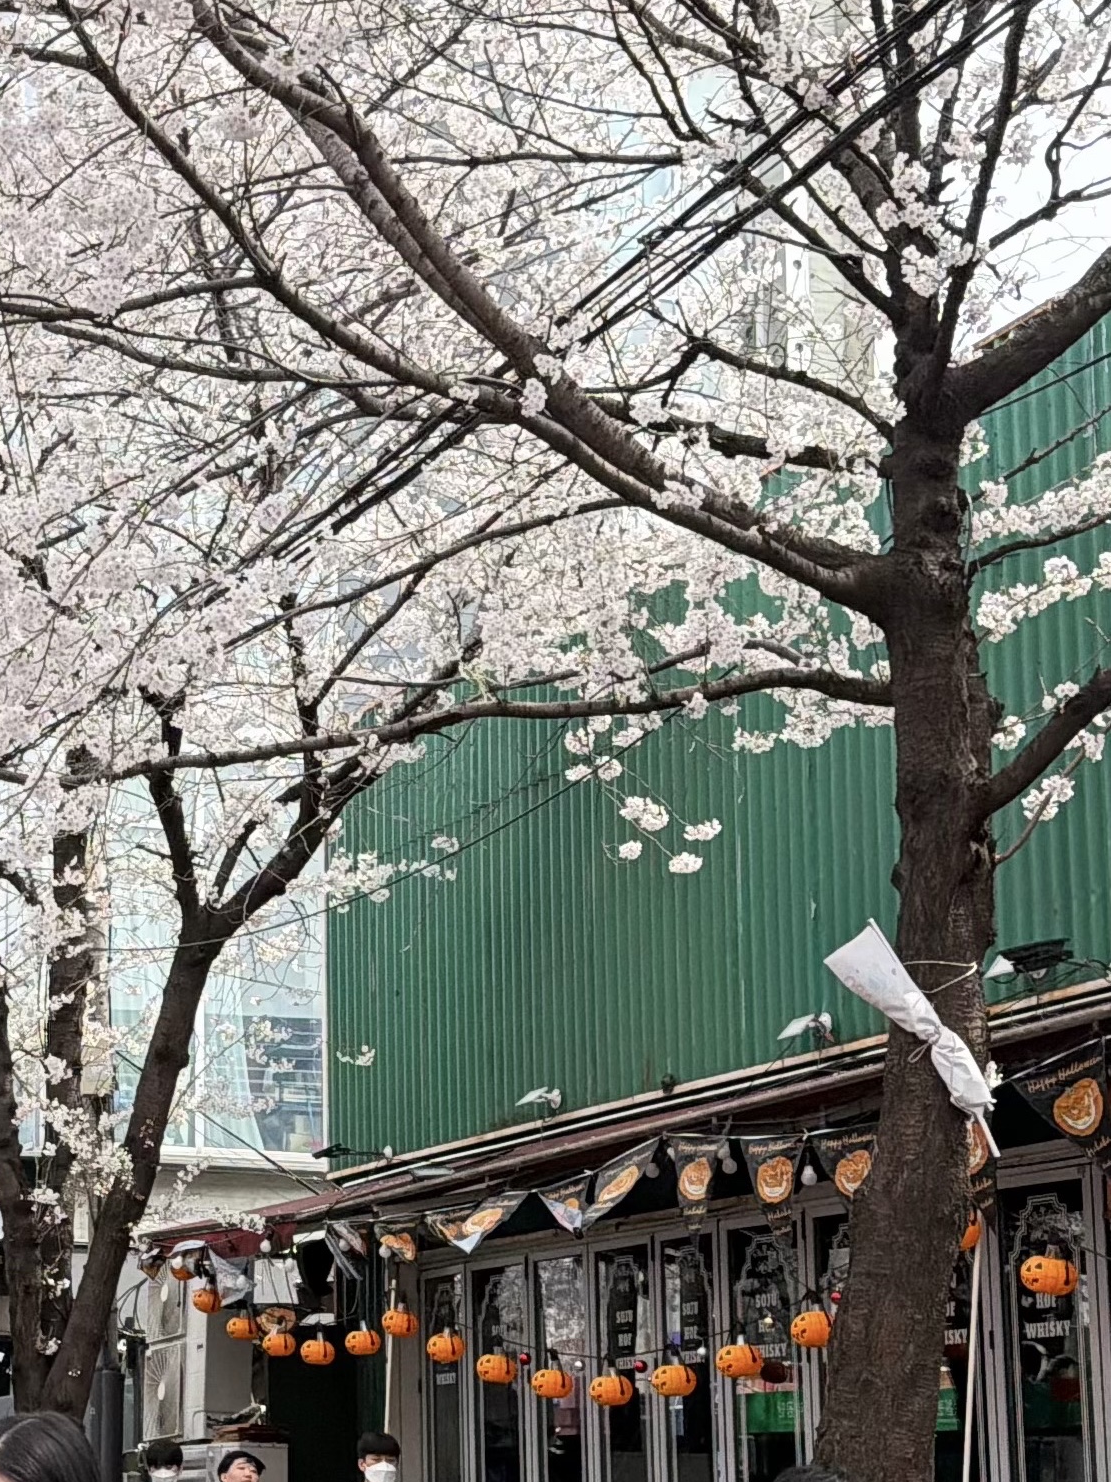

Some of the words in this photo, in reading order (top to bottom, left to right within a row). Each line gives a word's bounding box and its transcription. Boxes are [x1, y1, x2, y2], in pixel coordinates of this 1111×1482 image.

[944, 1328, 968, 1346] ISKY
[1023, 1319, 1071, 1340] WHISKY
[759, 1342, 787, 1358] HISKY
